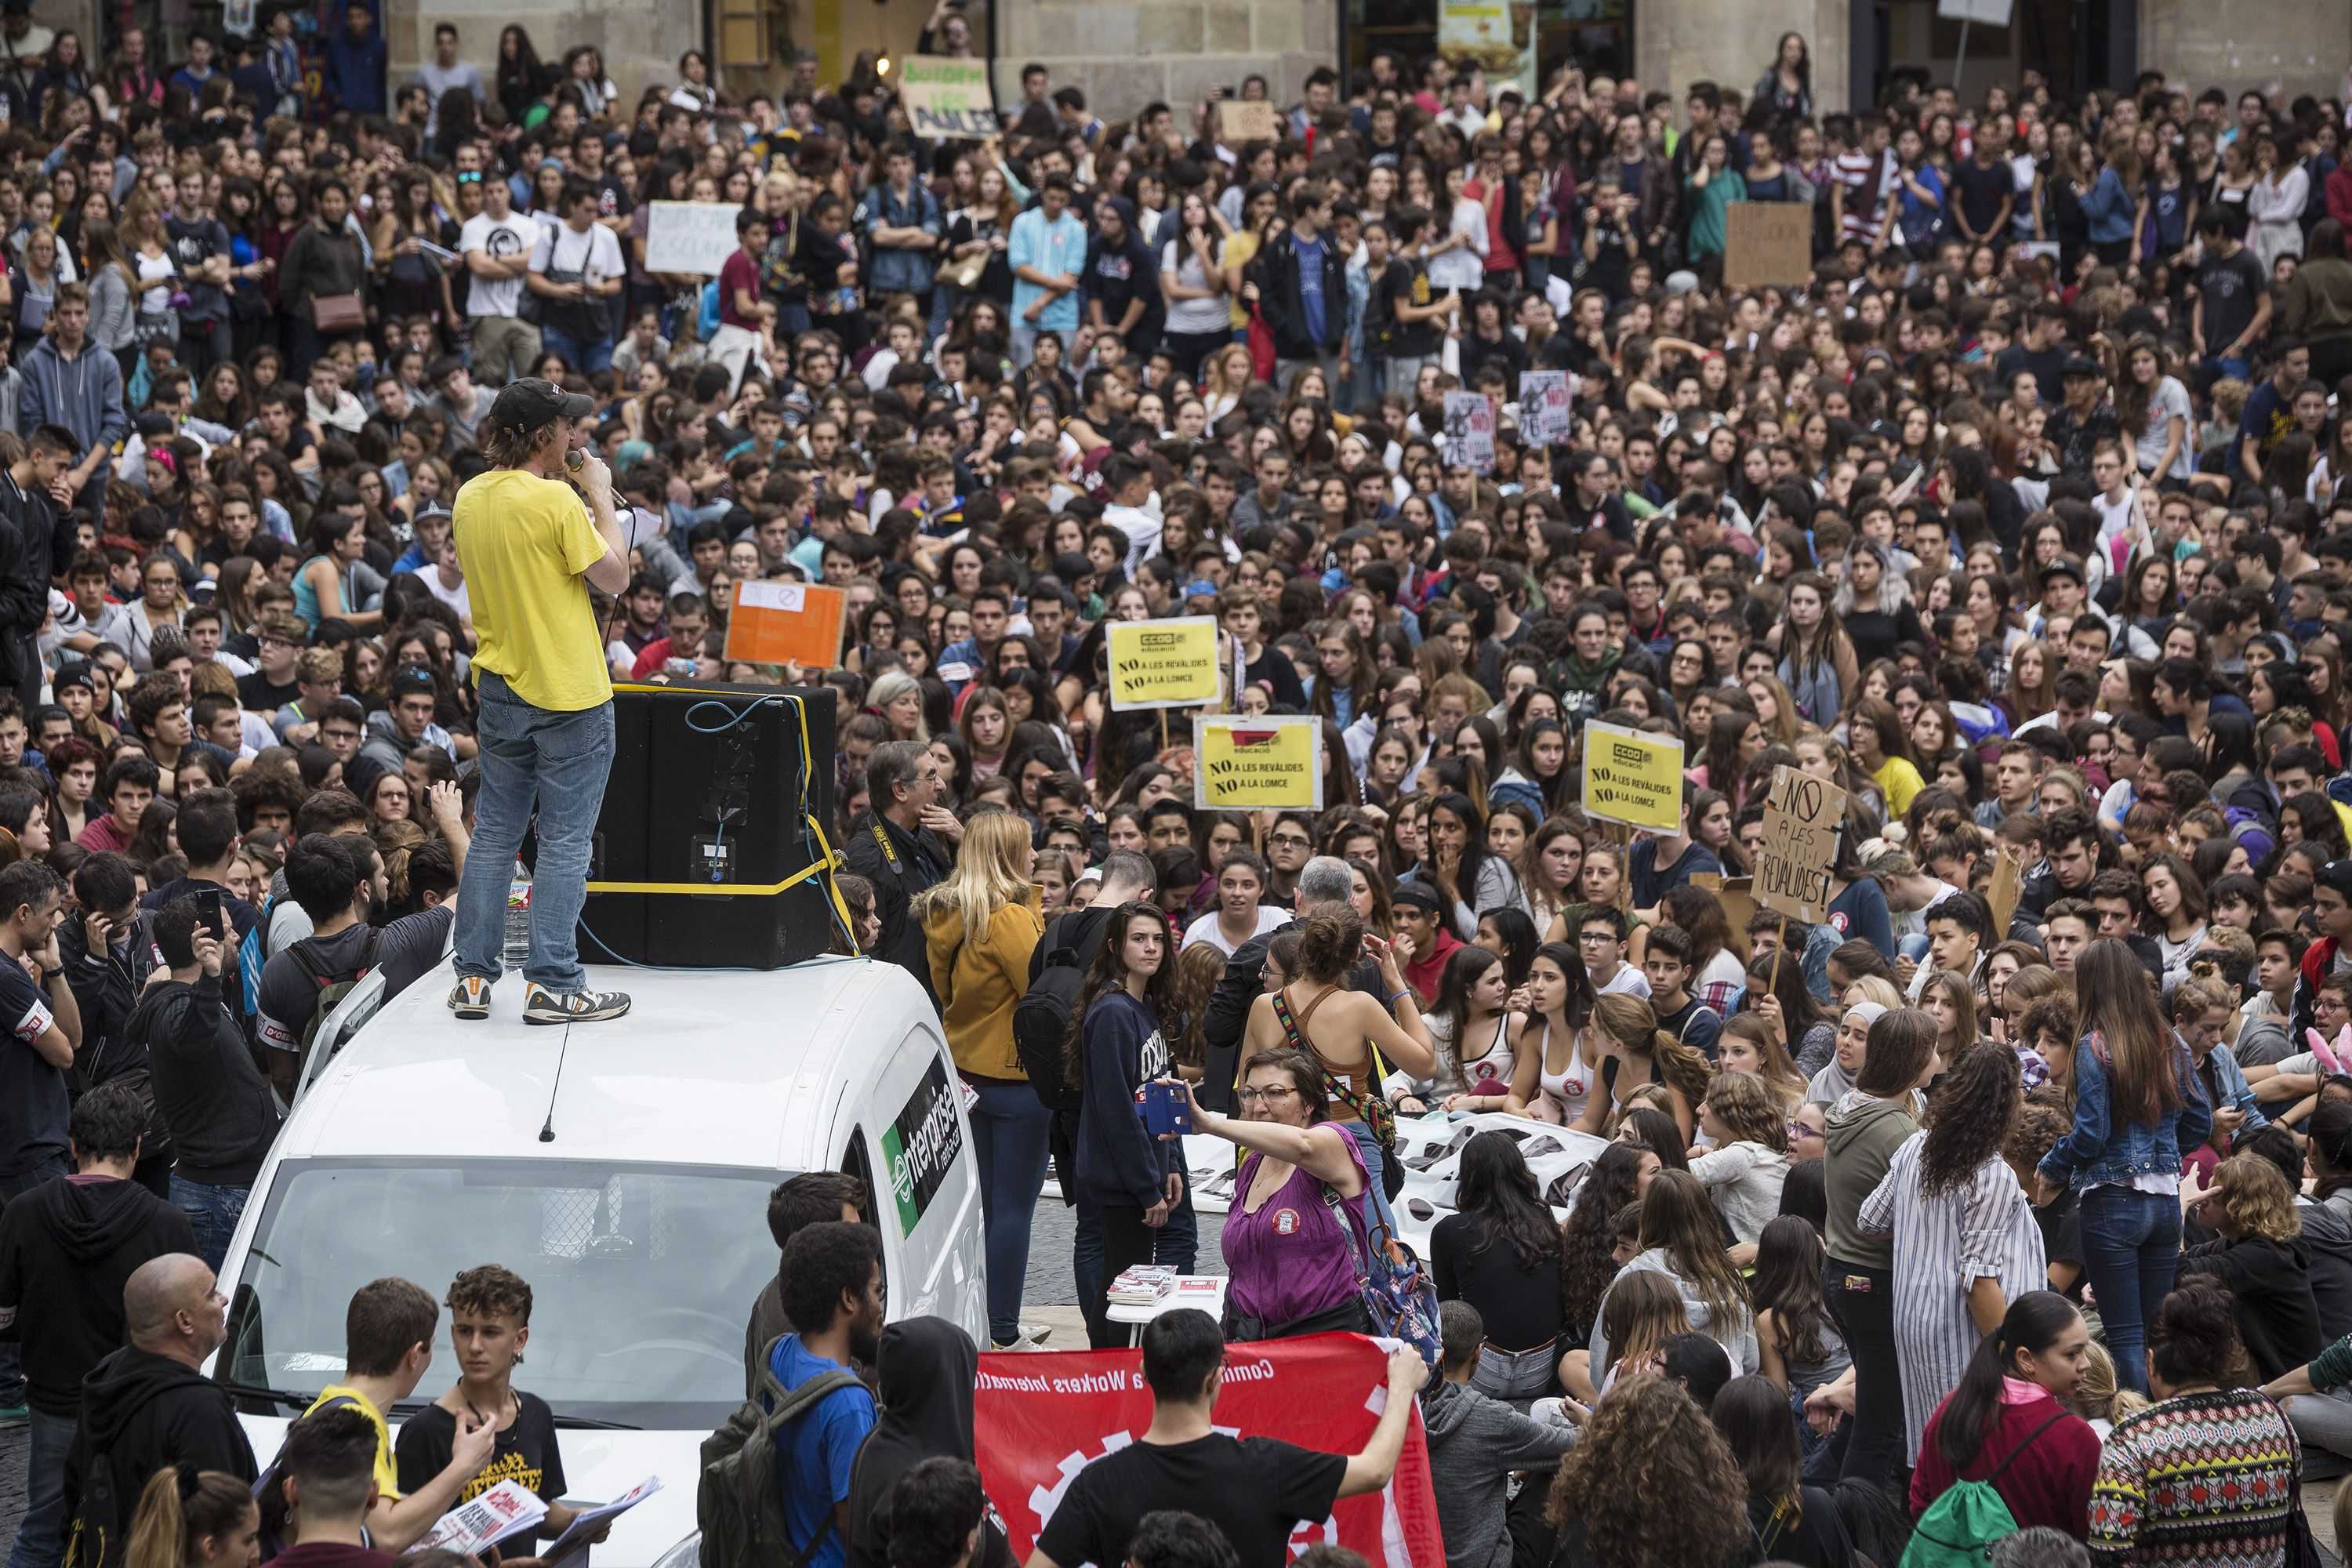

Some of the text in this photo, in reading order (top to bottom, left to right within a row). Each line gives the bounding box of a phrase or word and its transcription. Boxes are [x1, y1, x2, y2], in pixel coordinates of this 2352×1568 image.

[1118, 659, 1138, 674] NO
[1149, 660, 1163, 670] LES
[1123, 677, 1145, 692] NO
[1154, 675, 1165, 684] LA
[1166, 674, 1193, 684] LOMCE
[1613, 743, 1642, 761] CCOO
[1209, 759, 1232, 776] NO
[1243, 764, 1258, 772] LES
[1259, 762, 1304, 772] REVÀLIDES
[1613, 758, 1643, 770] educació
[1214, 779, 1238, 796] NO
[1247, 779, 1258, 788] LA
[1261, 779, 1288, 788] LOMCE
[1592, 768, 1610, 782] NO
[1618, 775, 1631, 786] LES
[1632, 777, 1672, 796] REVÀLIDES
[1595, 788, 1613, 803] NO
[1621, 792, 1630, 801] LA
[1631, 794, 1656, 808] LOMCE
[1782, 776, 1822, 822] NO
[1779, 819, 1815, 846] A LES
[883, 840, 895, 860] Nikon
[892, 1083, 956, 1203] enterprise
[940, 1125, 961, 1171] rent-a-car
